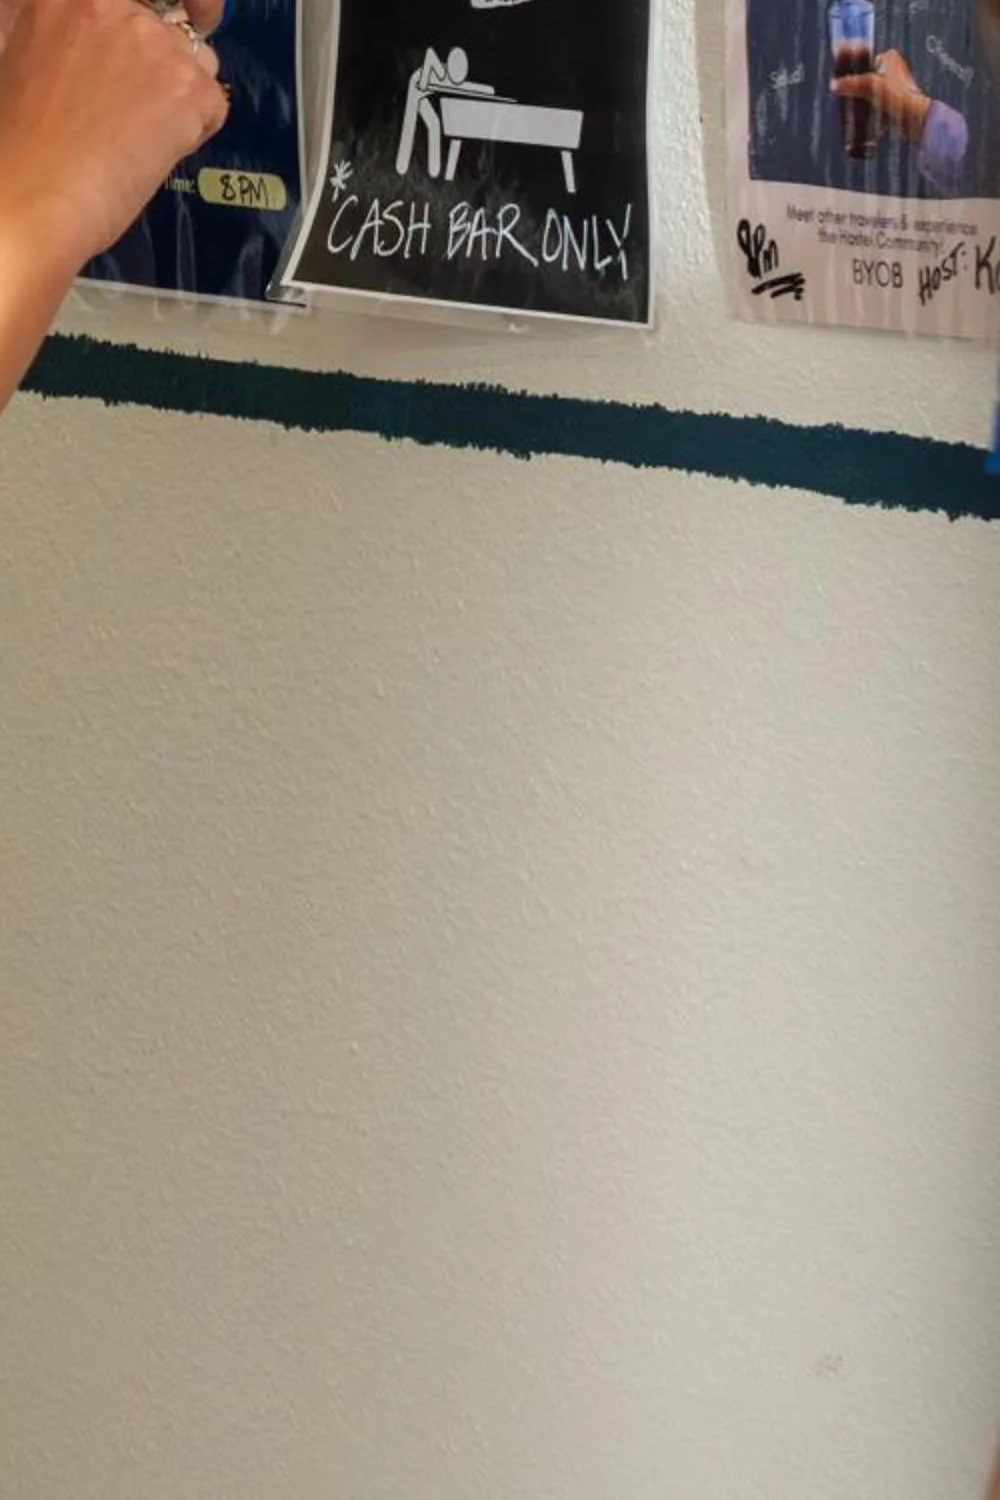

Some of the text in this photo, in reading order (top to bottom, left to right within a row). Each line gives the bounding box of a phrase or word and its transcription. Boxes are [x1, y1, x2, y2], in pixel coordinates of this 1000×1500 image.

[787, 204, 815, 223] Meet
[817, 207, 847, 224] other
[327, 196, 632, 282] CASH BAR ONLY
[818, 227, 837, 244] the
[838, 229, 874, 247] Hostel
[852, 258, 904, 288] BYOB
